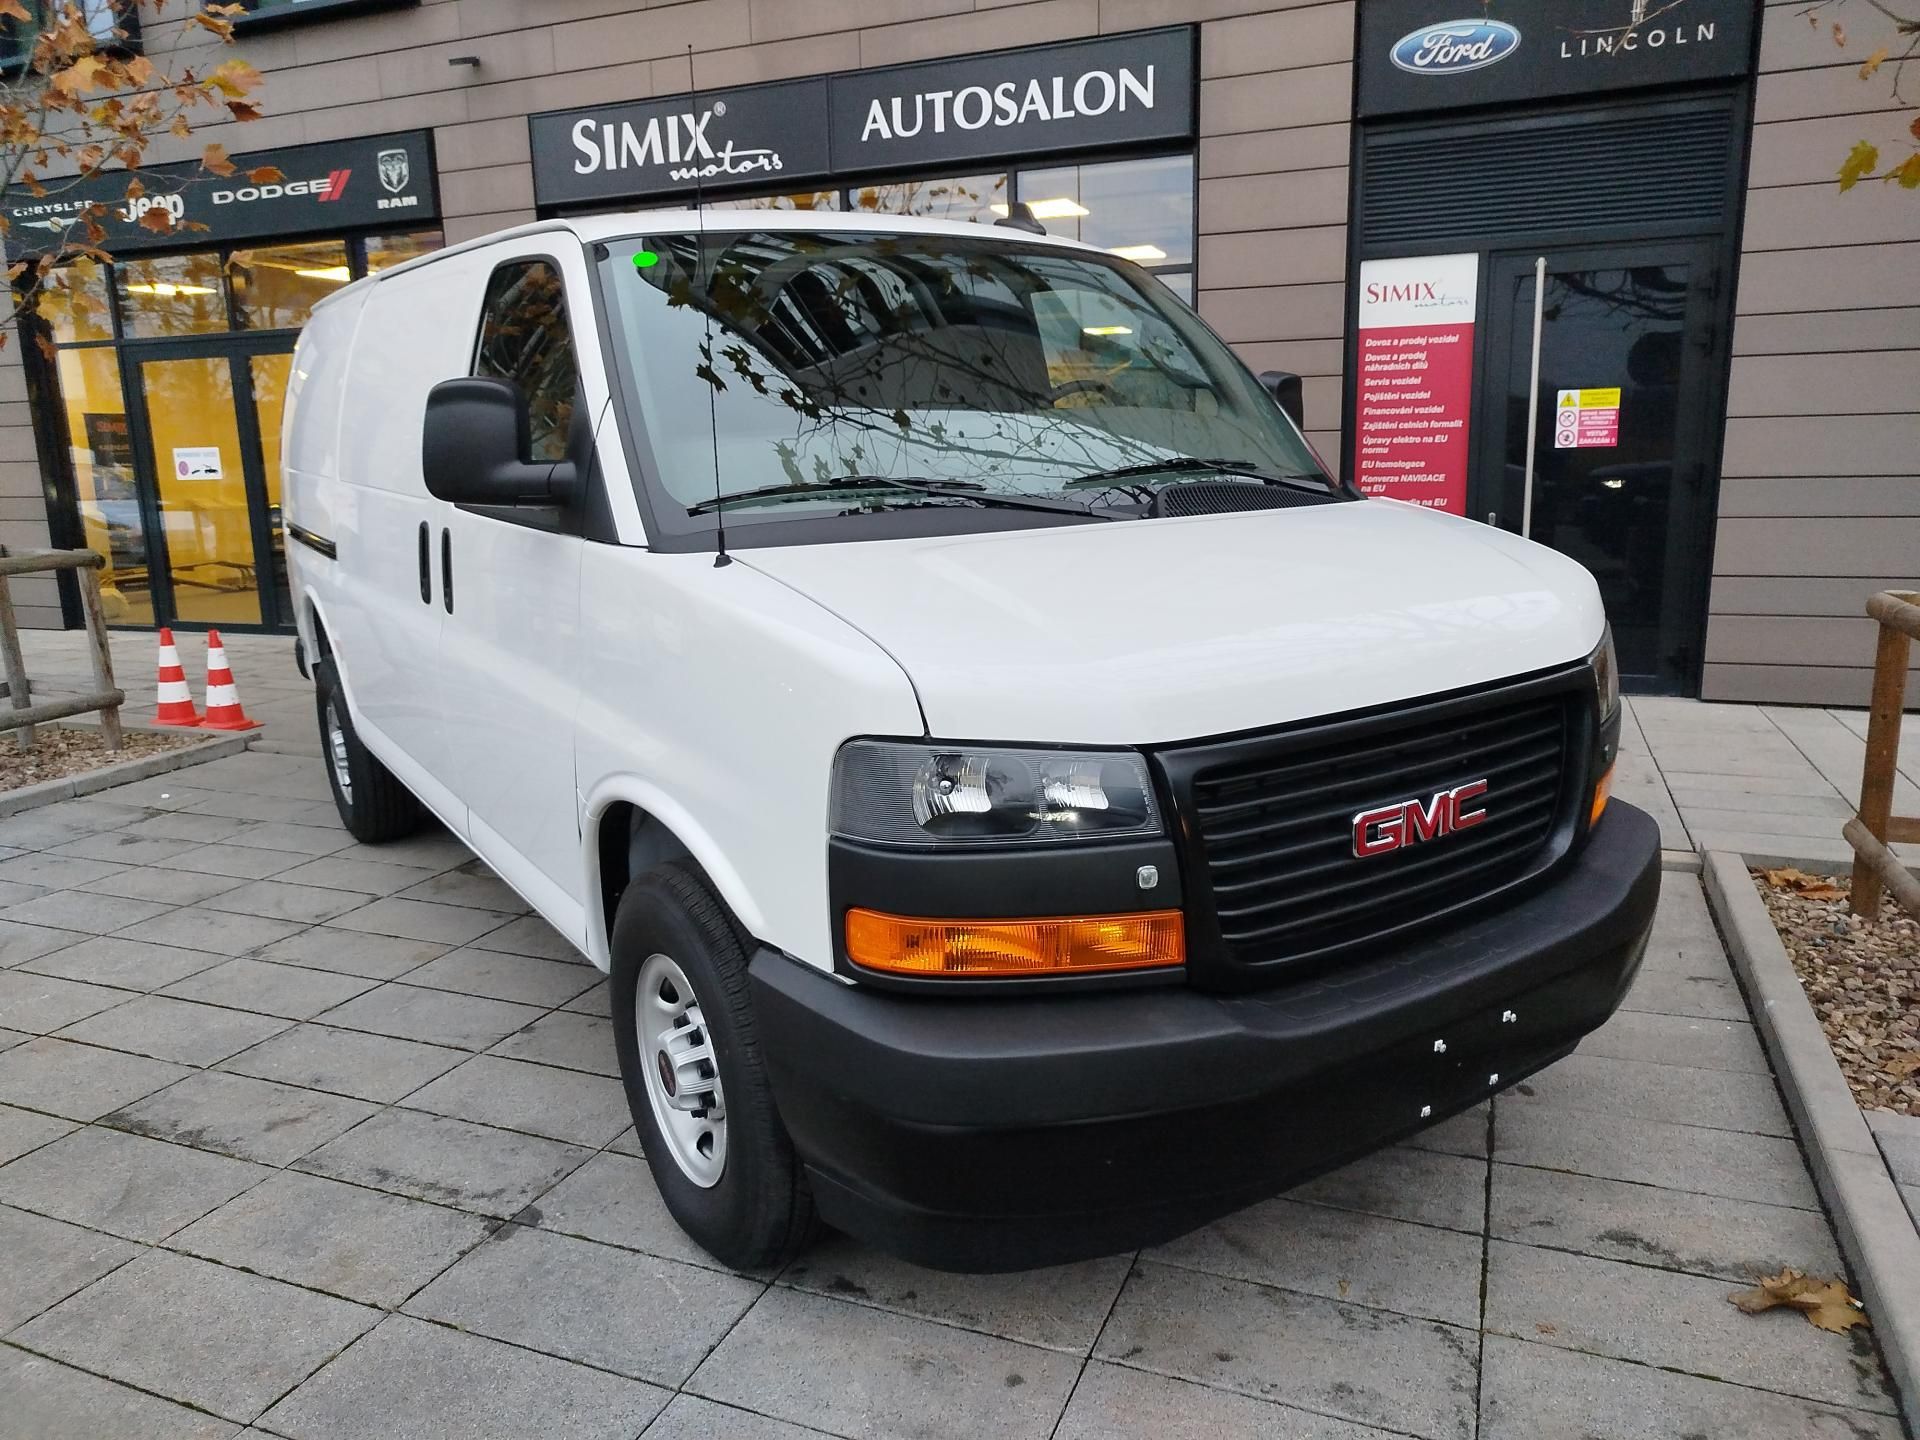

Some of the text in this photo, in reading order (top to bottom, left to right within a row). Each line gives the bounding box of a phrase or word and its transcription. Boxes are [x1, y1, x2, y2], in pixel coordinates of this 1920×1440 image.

[1560, 22, 1715, 58] LINCOLN
[1414, 28, 1495, 67] Ford
[860, 64, 1155, 142] AUTOSALON
[669, 140, 784, 181] motors
[211, 178, 333, 205] DODGE
[377, 196, 418, 210] RAM
[1367, 282, 1436, 304] SIMIX
[1365, 338, 1392, 347] Dovoz
[1399, 336, 1428, 346] prodej
[1428, 334, 1460, 344] vozidel
[1364, 353, 1391, 362] Dovoz
[1399, 351, 1427, 361] prodej
[1364, 376, 1422, 386] Servis vozidel
[1401, 390, 1431, 400] vozidel
[1414, 405, 1445, 414] vozidel
[1429, 419, 1463, 429] formalit
[1362, 435, 1392, 446] Úpravy
[1392, 435, 1421, 444] elektro
[1434, 434, 1448, 443] EU
[1362, 446, 1389, 454] normu
[1361, 460, 1426, 469] EU homologace
[1361, 473, 1446, 483] Konverze NAVIGACE
[1360, 484, 1386, 493] na EU
[1421, 499, 1433, 507] na
[1433, 497, 1448, 507] EU
[1352, 778, 1488, 858] GMC
